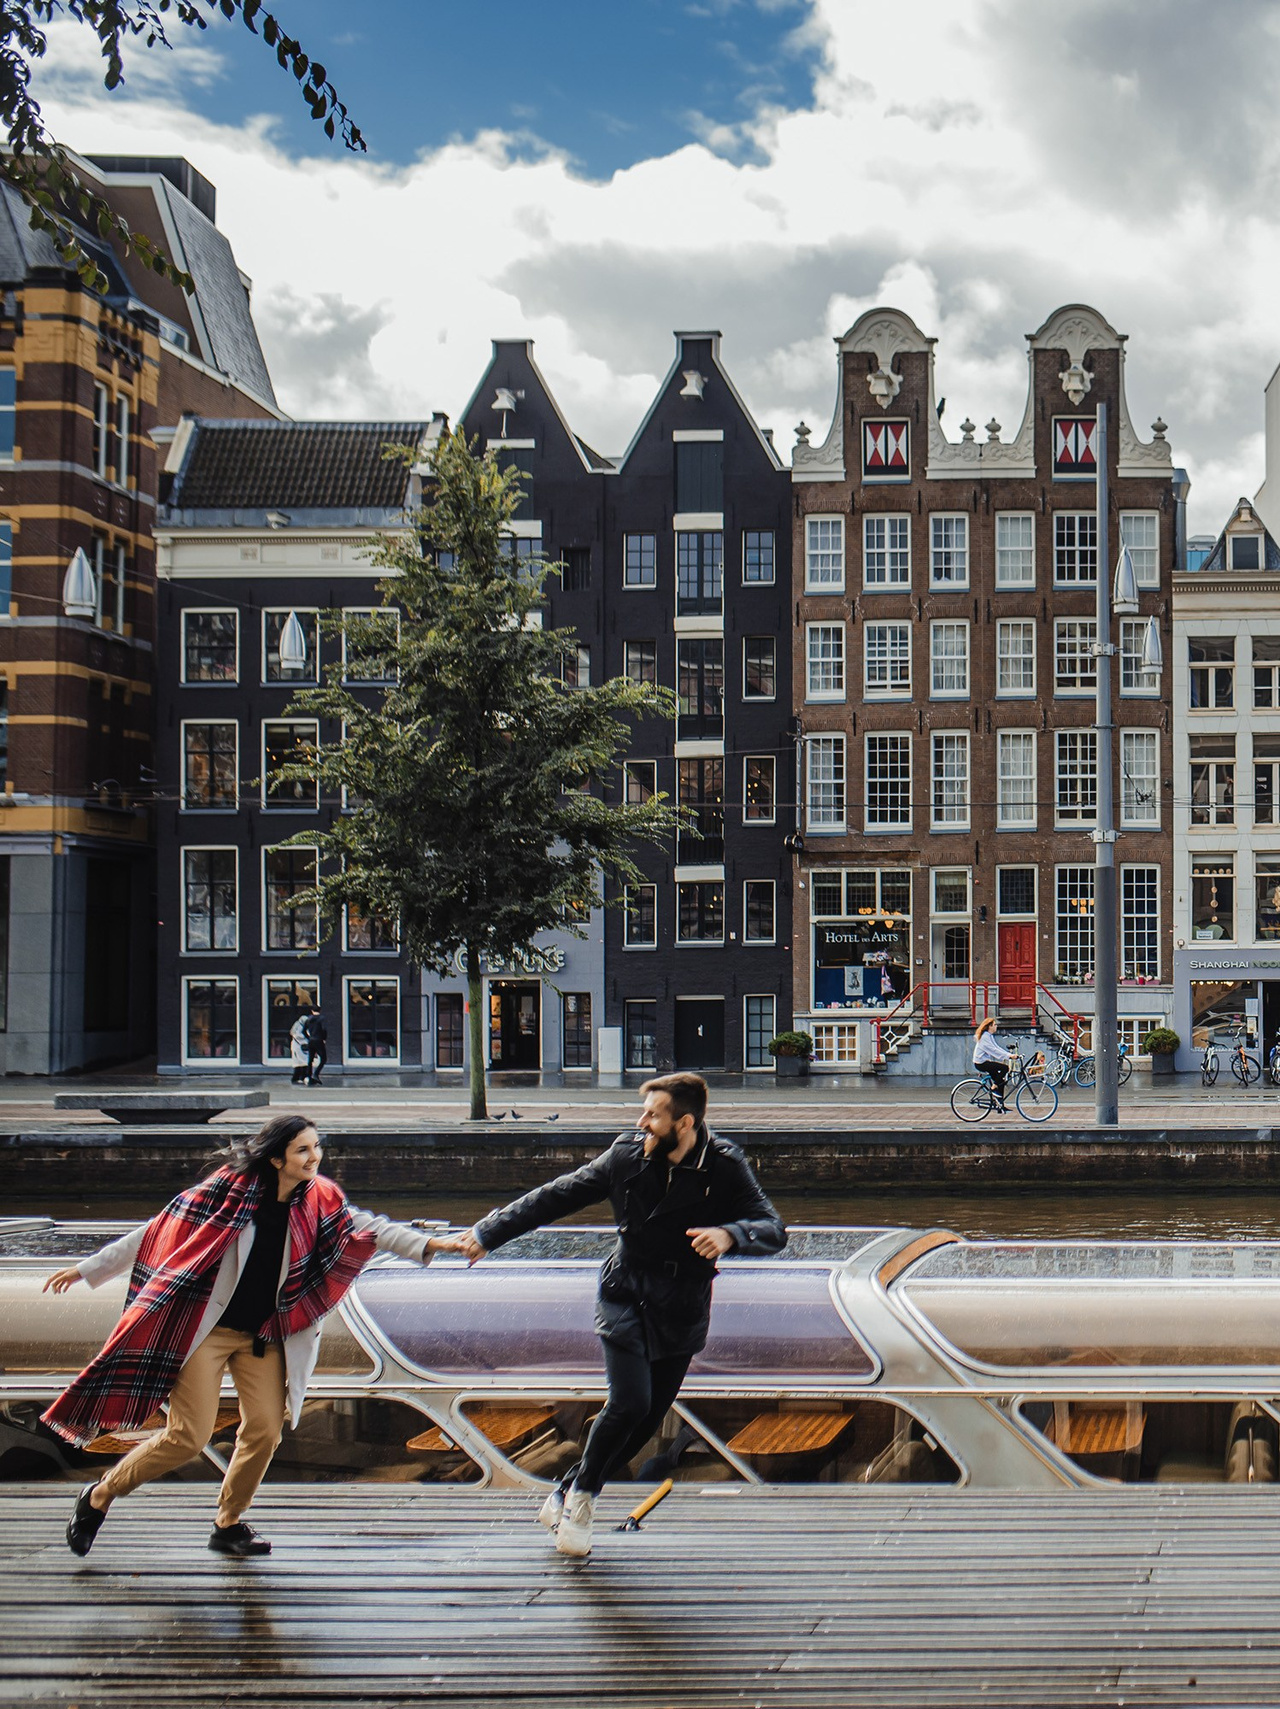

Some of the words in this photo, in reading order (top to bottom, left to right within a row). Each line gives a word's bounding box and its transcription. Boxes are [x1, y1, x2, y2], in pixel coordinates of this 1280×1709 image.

[825, 932, 860, 943] HOTEL
[871, 931, 899, 942] ARTS
[1189, 960, 1249, 969] SHANGHAI
